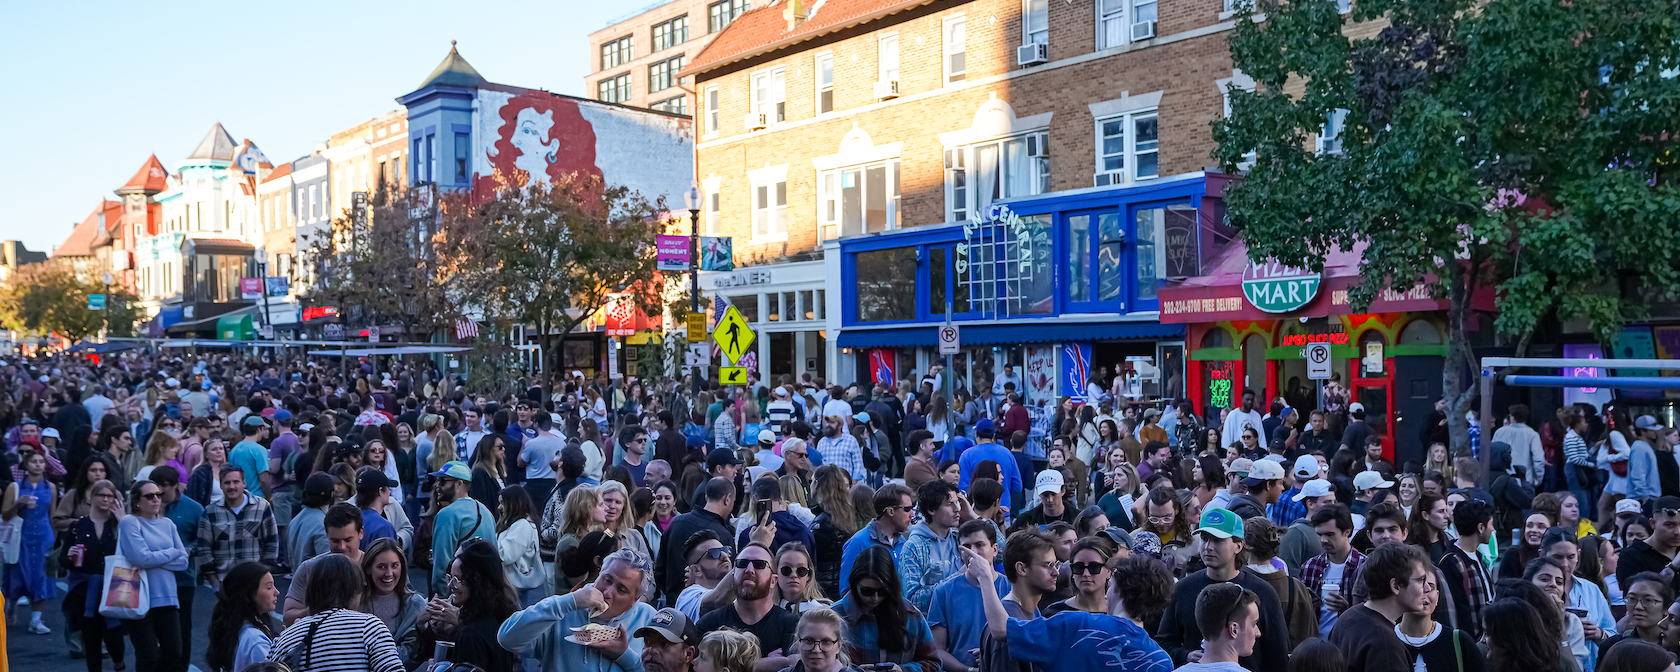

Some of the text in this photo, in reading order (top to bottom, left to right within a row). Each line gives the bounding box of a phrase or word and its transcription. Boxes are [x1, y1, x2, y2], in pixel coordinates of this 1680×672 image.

[989, 205, 1031, 273] CENTRAL
[1251, 280, 1315, 306] MART
[1202, 299, 1215, 312] FREE
[1216, 297, 1243, 312] DELIVERY!
[1282, 334, 1307, 346] JUMBO
[1329, 332, 1349, 344] PIZZA
[1209, 379, 1231, 389] JUMBO
[1211, 389, 1229, 399] SLICE
[1211, 398, 1229, 408] PIZZA
